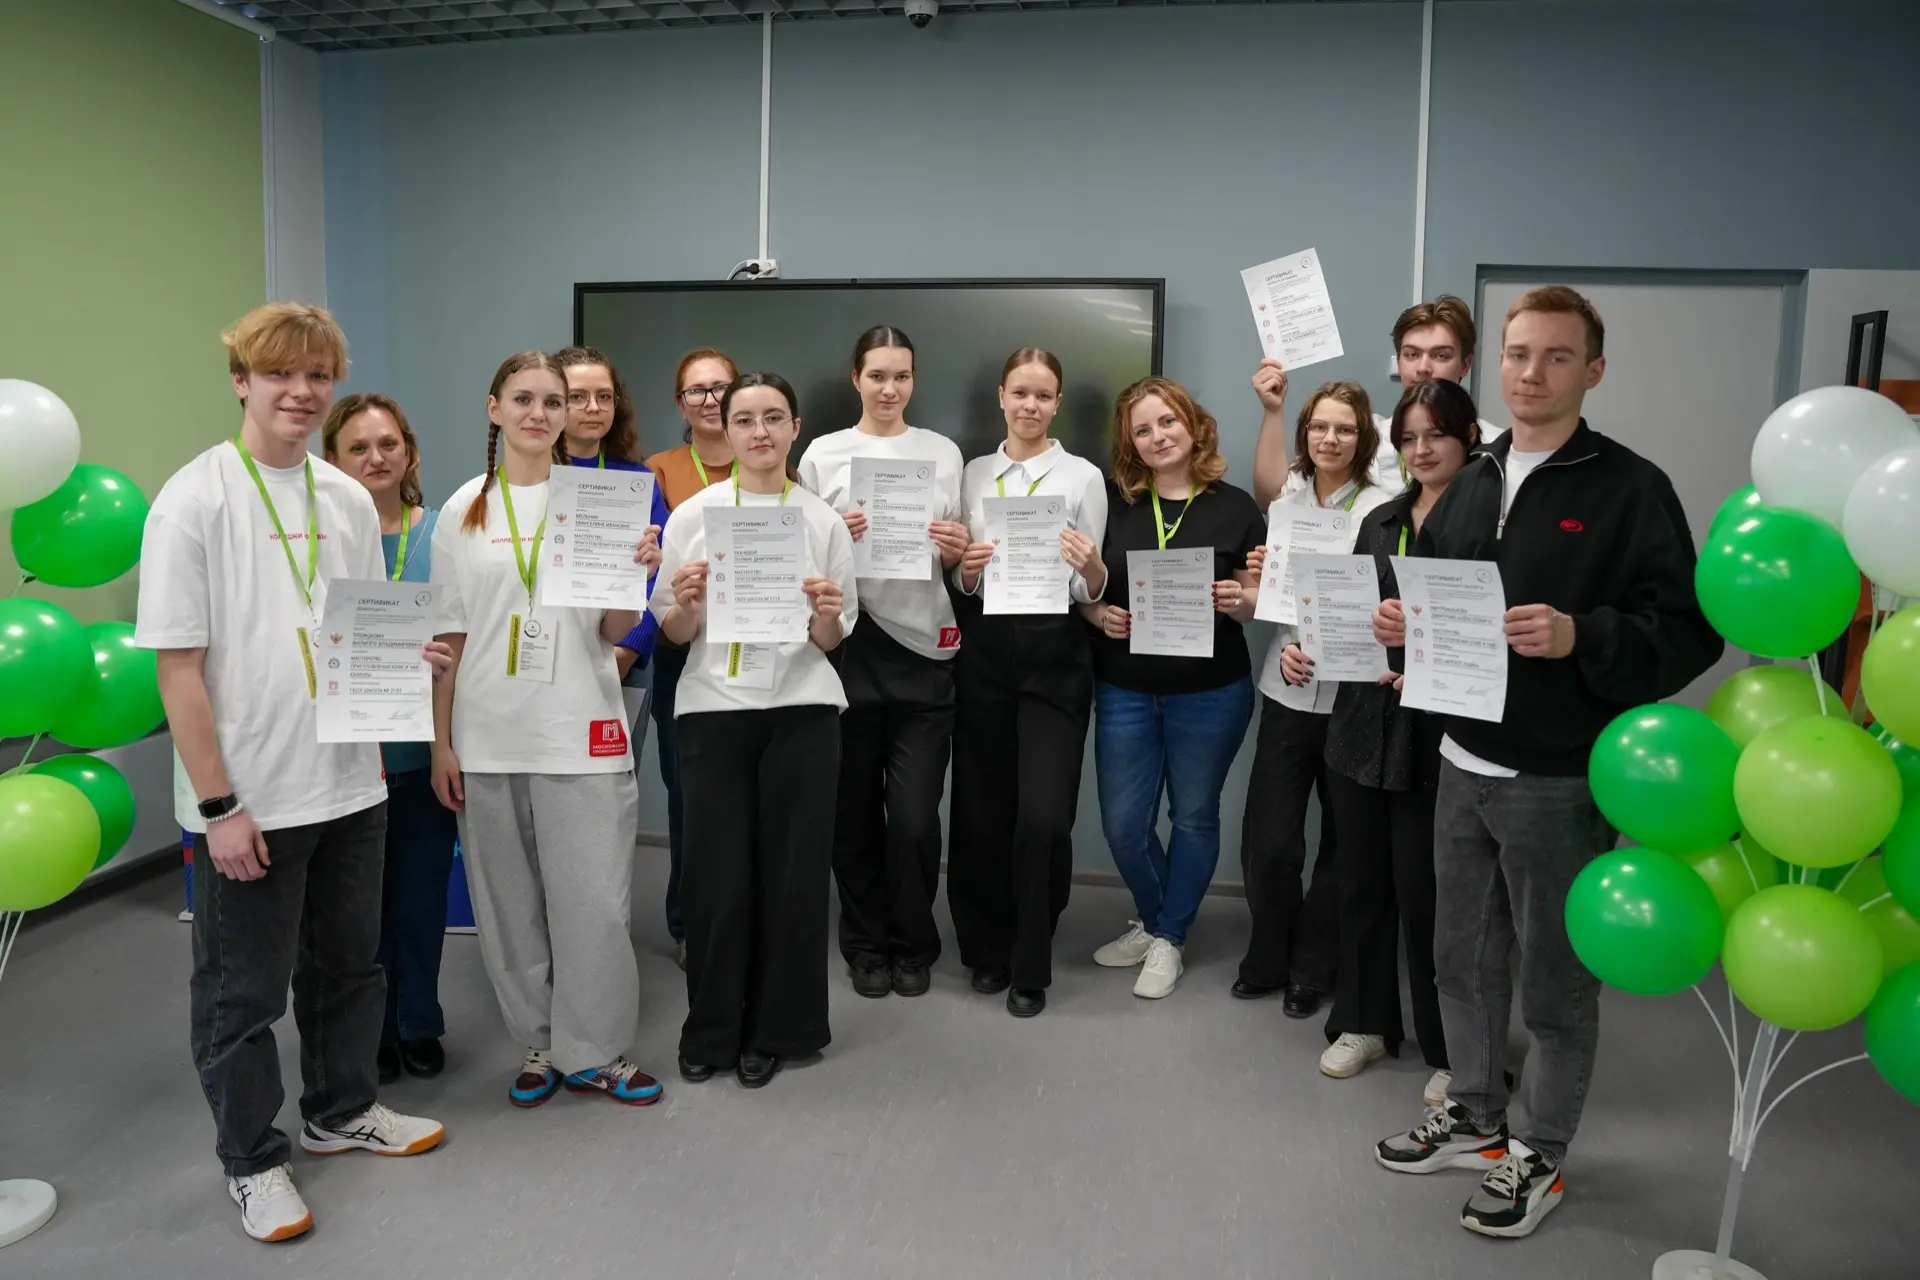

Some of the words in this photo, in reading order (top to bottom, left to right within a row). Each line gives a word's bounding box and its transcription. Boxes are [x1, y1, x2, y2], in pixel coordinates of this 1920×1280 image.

[1292, 520, 1322, 528] СЕРТИФИКАТ
[1424, 574, 1463, 582] СЕРТИФИКАТ
[358, 598, 400, 606] СЕРТИФИКАТ
